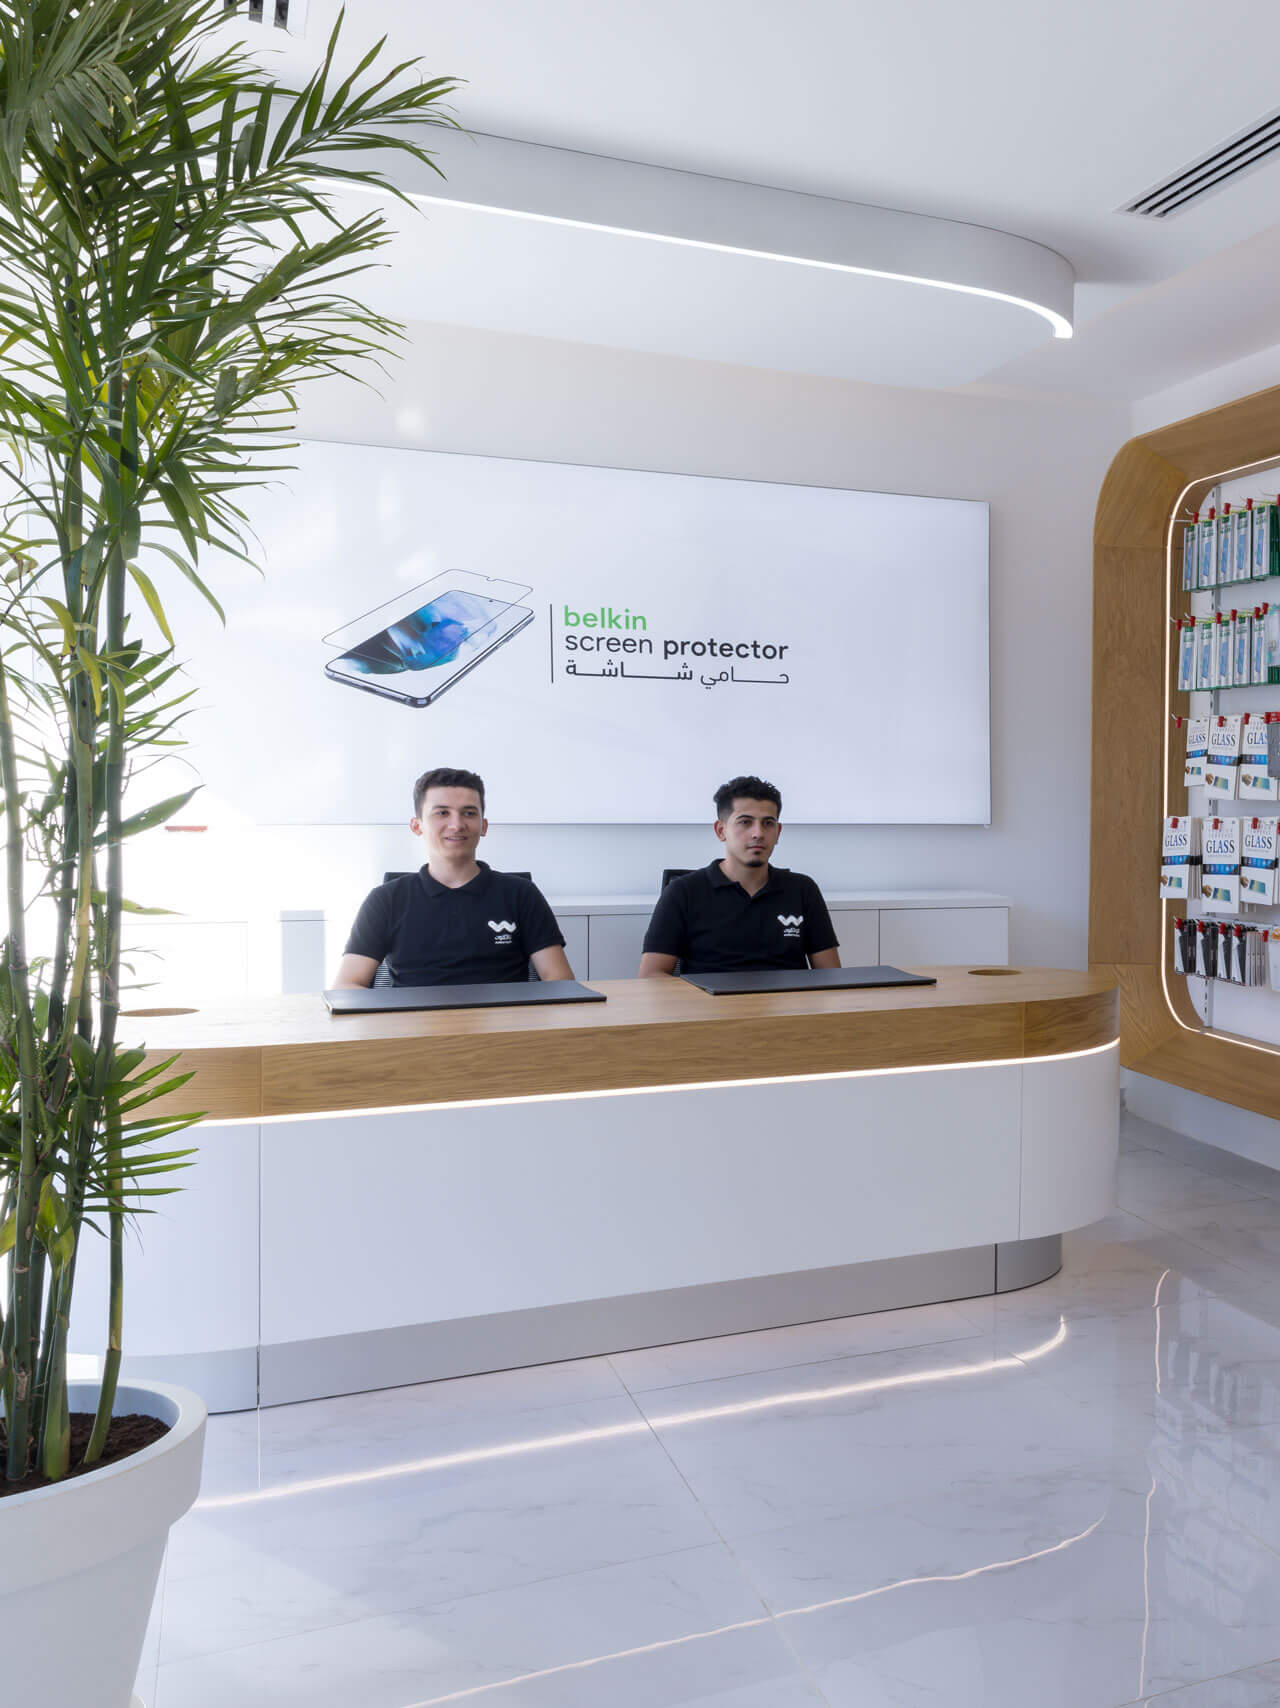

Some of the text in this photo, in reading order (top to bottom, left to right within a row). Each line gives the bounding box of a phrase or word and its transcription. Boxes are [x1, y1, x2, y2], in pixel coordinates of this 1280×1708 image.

[564, 605, 647, 631] belkin
[564, 635, 790, 660] screen protector
[1188, 733, 1206, 744] GLASS
[1211, 733, 1236, 747] GLASS
[1165, 834, 1188, 847] GLASS
[1206, 840, 1235, 854] GLASS
[1244, 834, 1273, 849] GLASS
